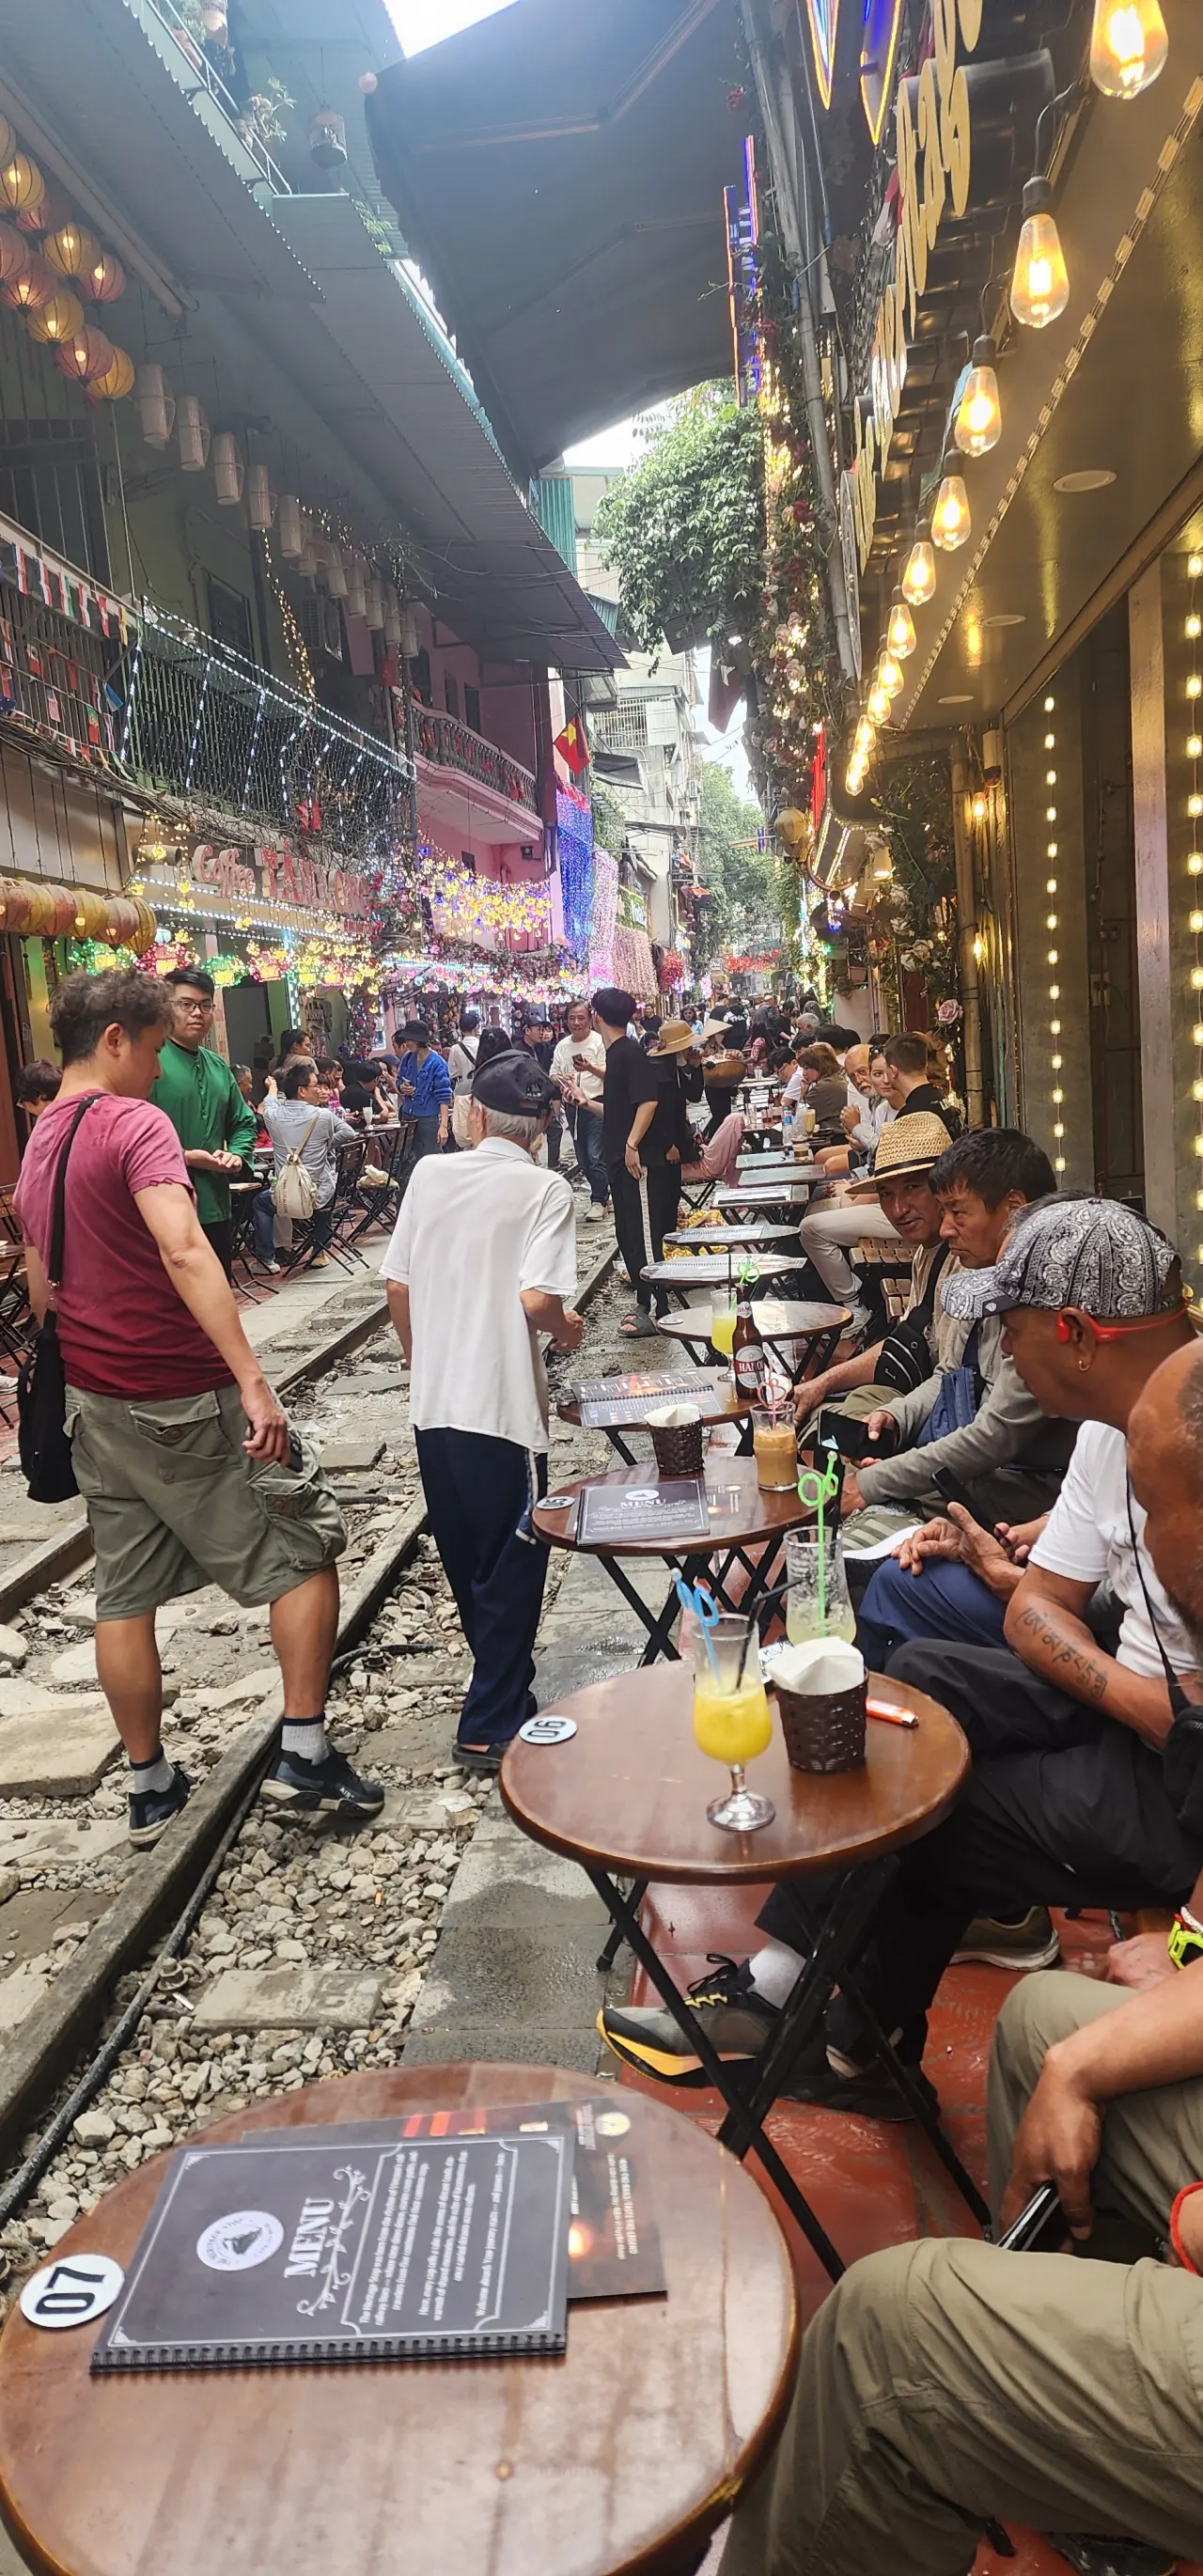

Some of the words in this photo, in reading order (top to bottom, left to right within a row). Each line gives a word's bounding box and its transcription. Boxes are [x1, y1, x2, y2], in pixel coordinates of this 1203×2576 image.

[193, 844, 255, 898] Coffee
[526, 1720, 567, 1738] 06
[284, 2197, 334, 2278] MENU
[35, 2266, 106, 2315] 07
